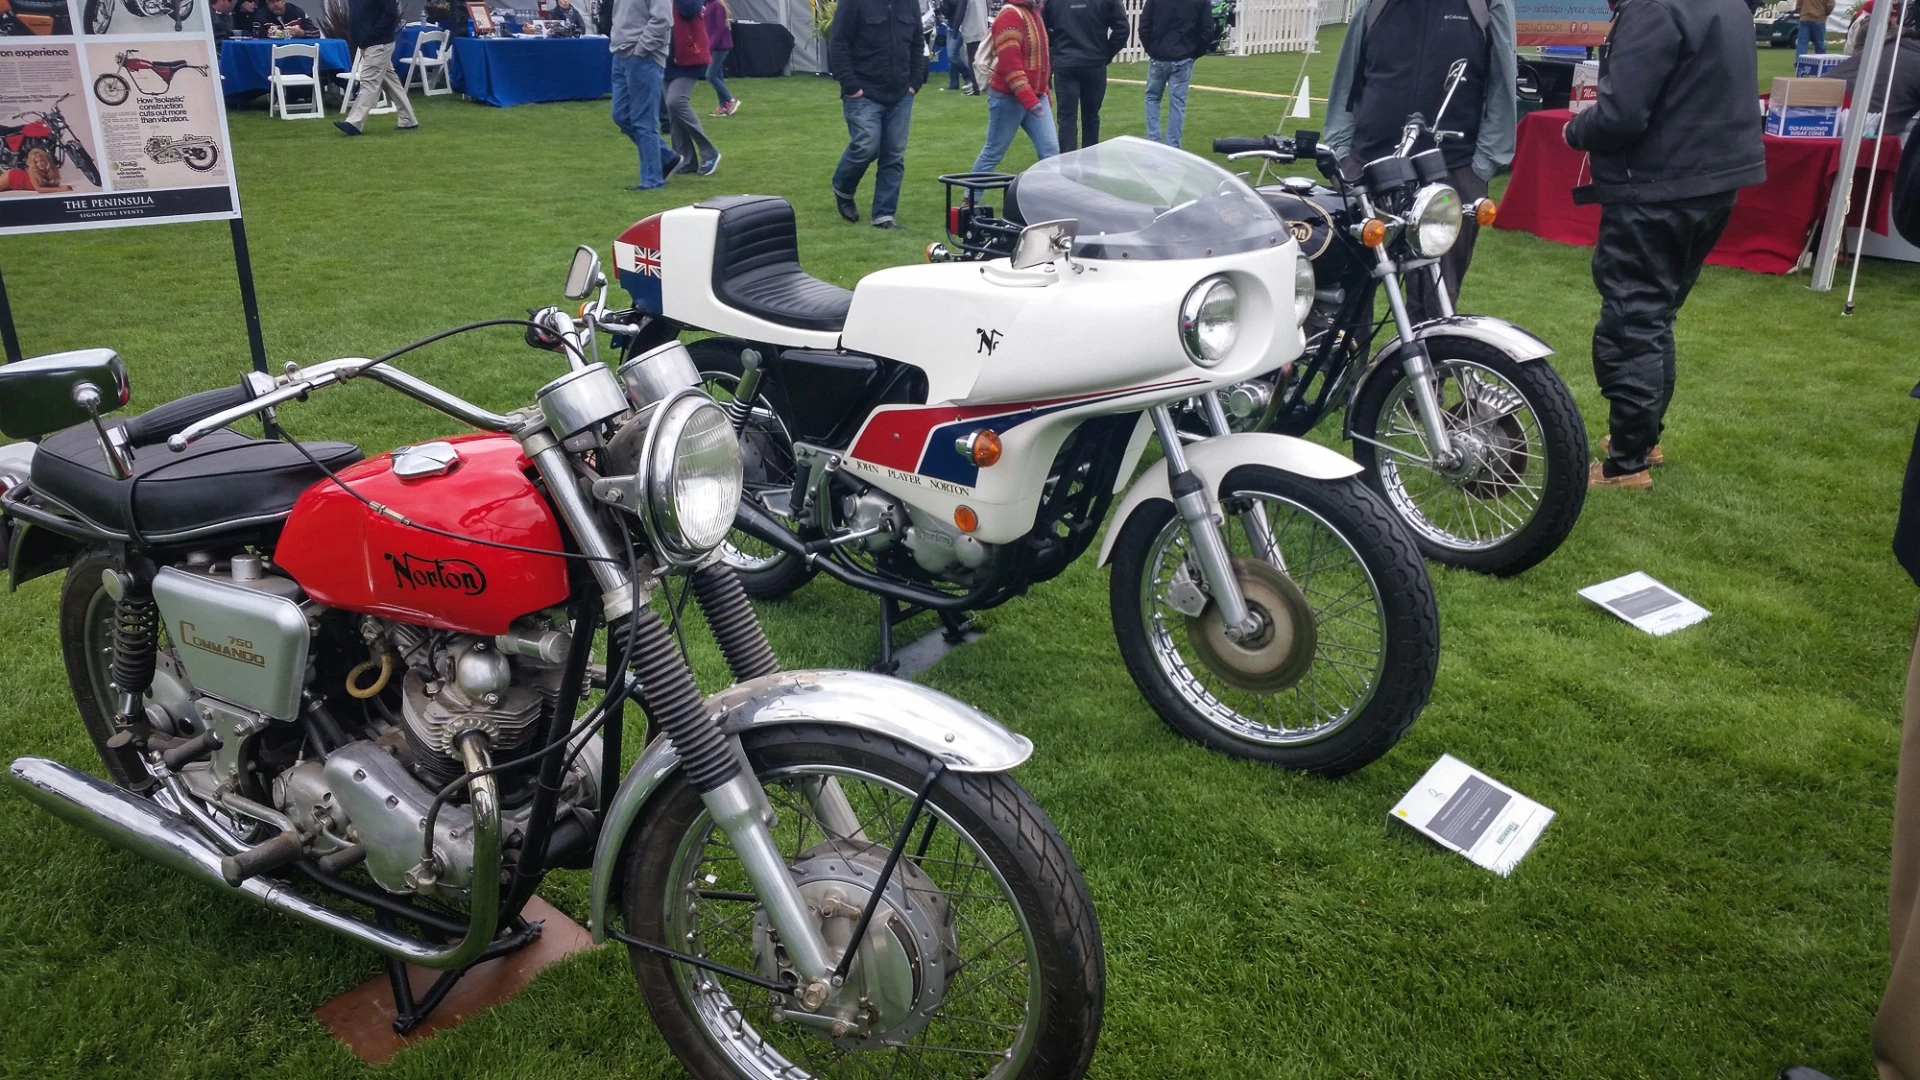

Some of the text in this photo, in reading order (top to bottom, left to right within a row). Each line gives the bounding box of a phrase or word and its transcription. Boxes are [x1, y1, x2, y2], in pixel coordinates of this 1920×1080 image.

[15, 47, 69, 59] experience
[139, 102, 184, 110] construction
[157, 115, 189, 123] vibration.
[63, 196, 154, 209] THE PENINSULA
[79, 210, 117, 218] SIGNATURE
[856, 461, 970, 496] JOHN PLAYER NORTON
[384, 551, 487, 596] Norton
[227, 635, 253, 649] 750
